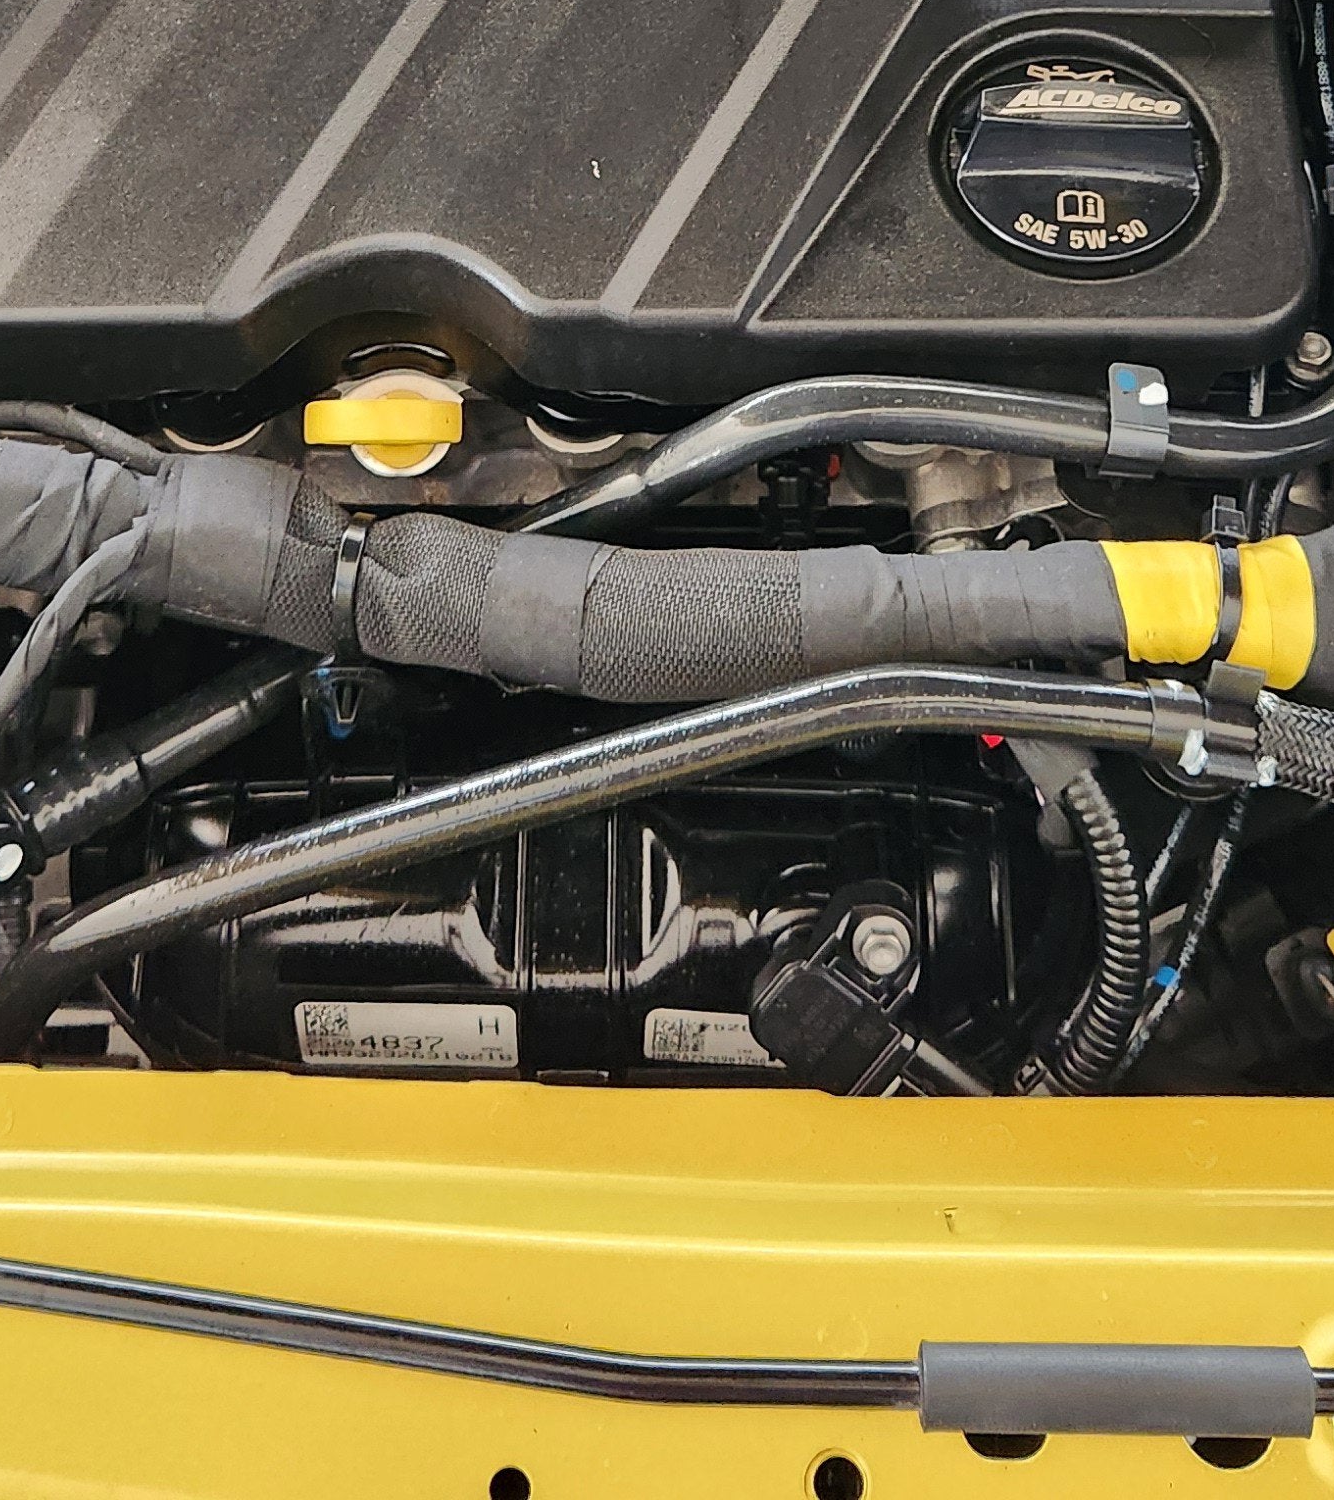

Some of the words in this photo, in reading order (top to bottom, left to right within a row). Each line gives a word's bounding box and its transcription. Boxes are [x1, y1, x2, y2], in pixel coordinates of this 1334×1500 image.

[1005, 89, 1182, 116] ACDelco
[1013, 213, 1060, 245] SAE
[1069, 219, 1149, 250] 5W-30
[478, 1015, 500, 1036] H
[360, 1034, 444, 1050] 4837
